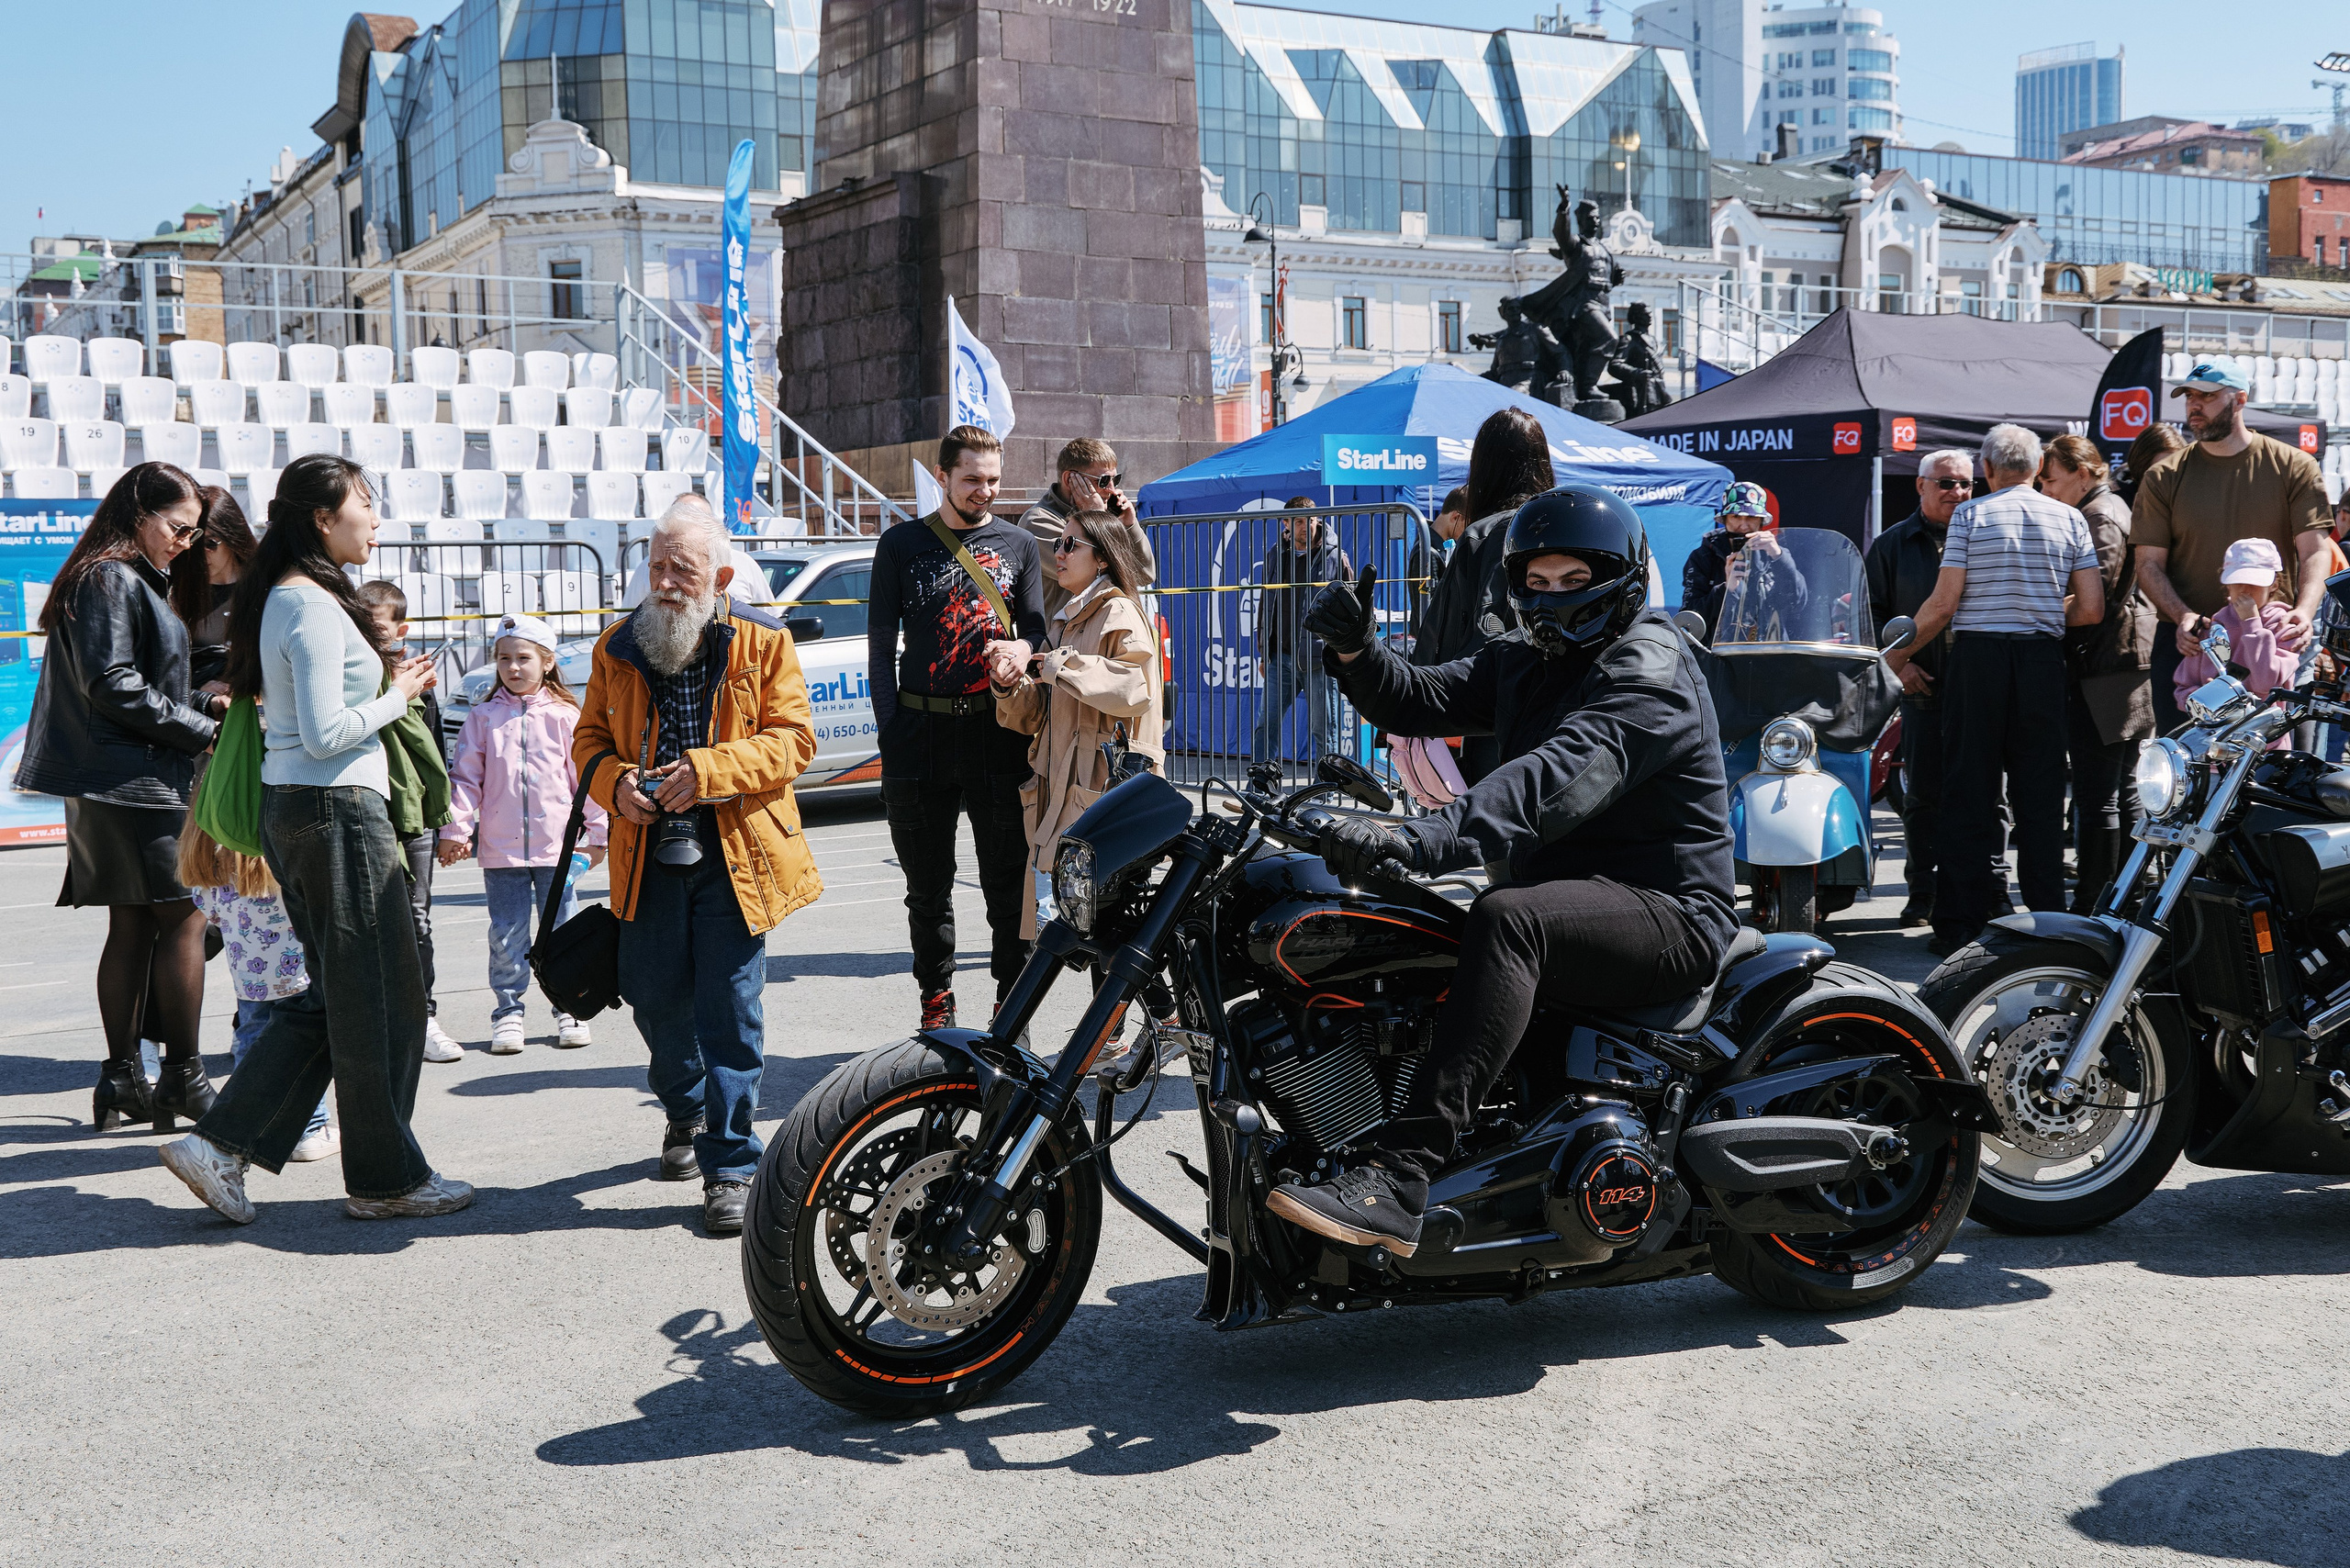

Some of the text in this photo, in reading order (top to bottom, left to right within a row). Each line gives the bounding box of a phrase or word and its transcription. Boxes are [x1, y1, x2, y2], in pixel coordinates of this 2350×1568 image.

[1262, 389, 1270, 414] 9
[2105, 401, 2148, 427] FQ
[19, 427, 35, 436] 19
[87, 429, 103, 438] 26
[1834, 430, 1859, 446] FQ
[1894, 426, 1915, 443] FQ
[2300, 431, 2317, 447] FQ
[1699, 431, 1720, 452] IN
[1725, 429, 1793, 451] JAPAN
[1337, 448, 1427, 470] StarLine
[46, 536, 74, 545] УМОМ
[568, 582, 575, 591] 9
[810, 701, 854, 712] ЕННЫЙ
[1340, 693, 1354, 757] Star
[1599, 1186, 1645, 1204] 114
